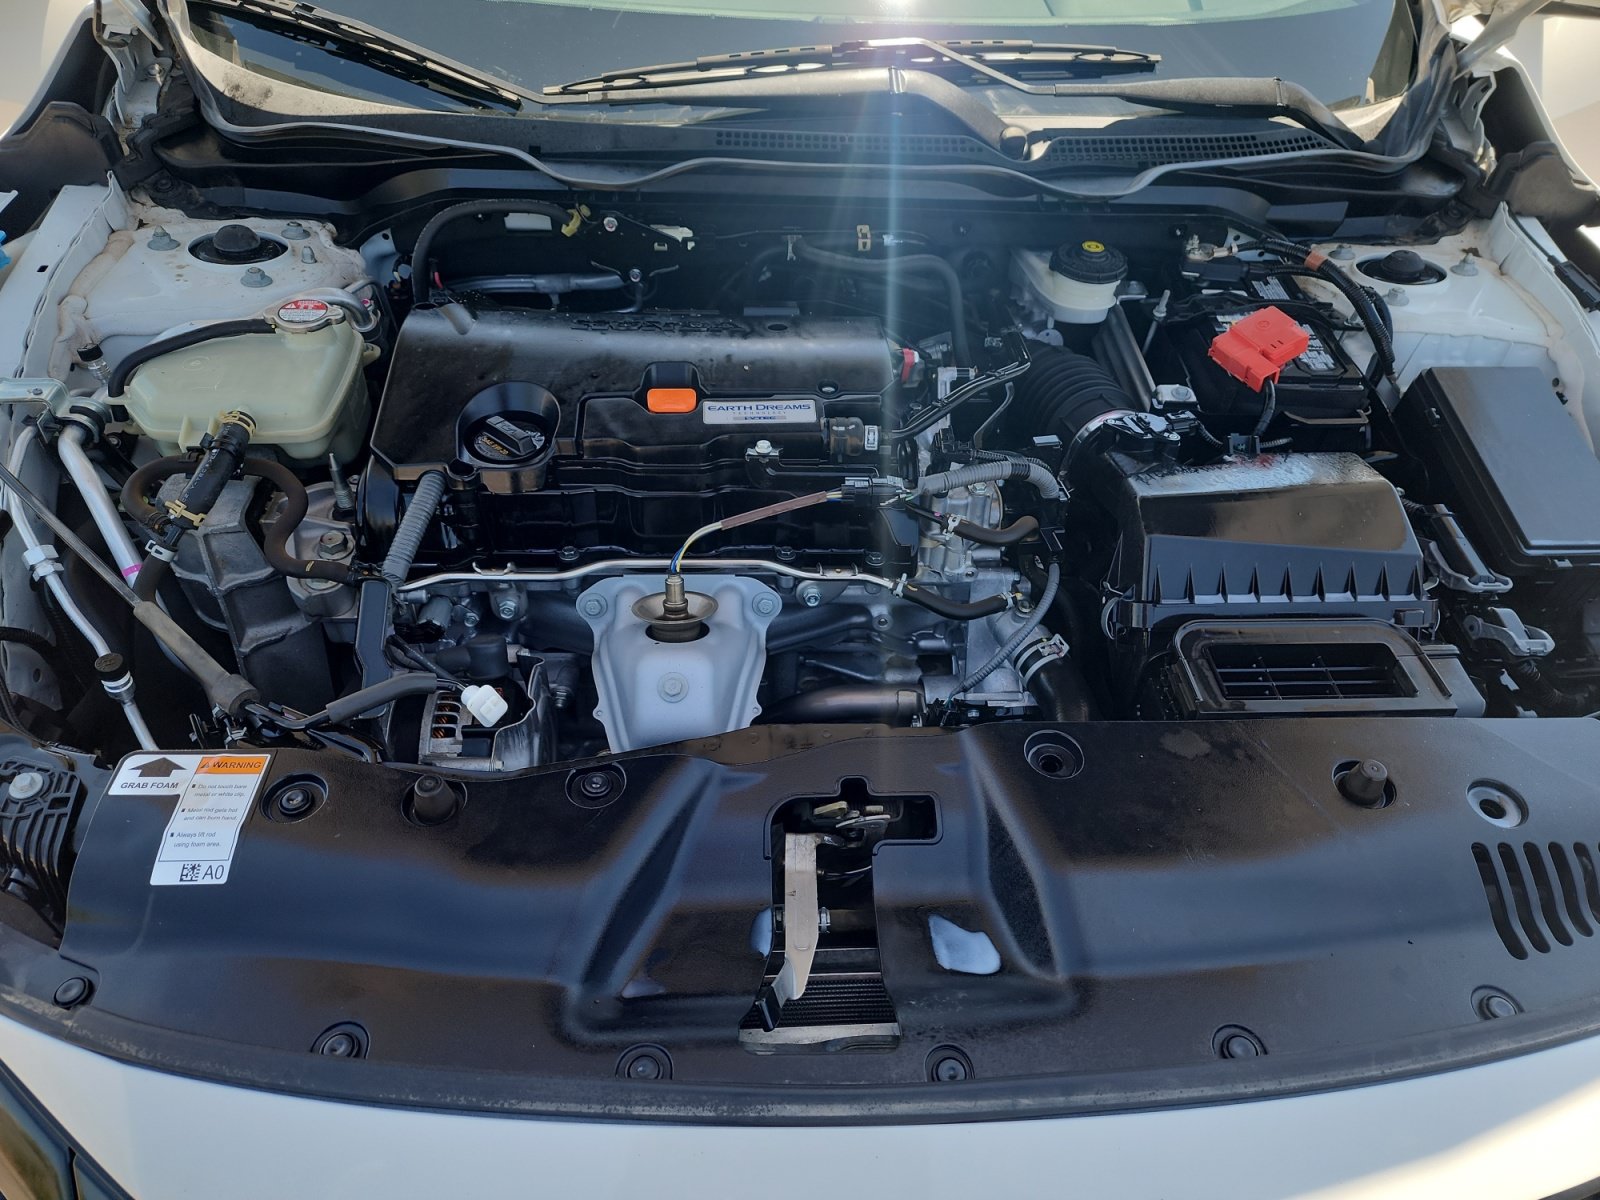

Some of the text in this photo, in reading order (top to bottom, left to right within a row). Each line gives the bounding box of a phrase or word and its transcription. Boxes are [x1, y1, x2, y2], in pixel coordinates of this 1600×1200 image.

[707, 403, 811, 412] EARTH DREAMS
[212, 761, 262, 769] WARNING
[202, 864, 224, 880] A0
